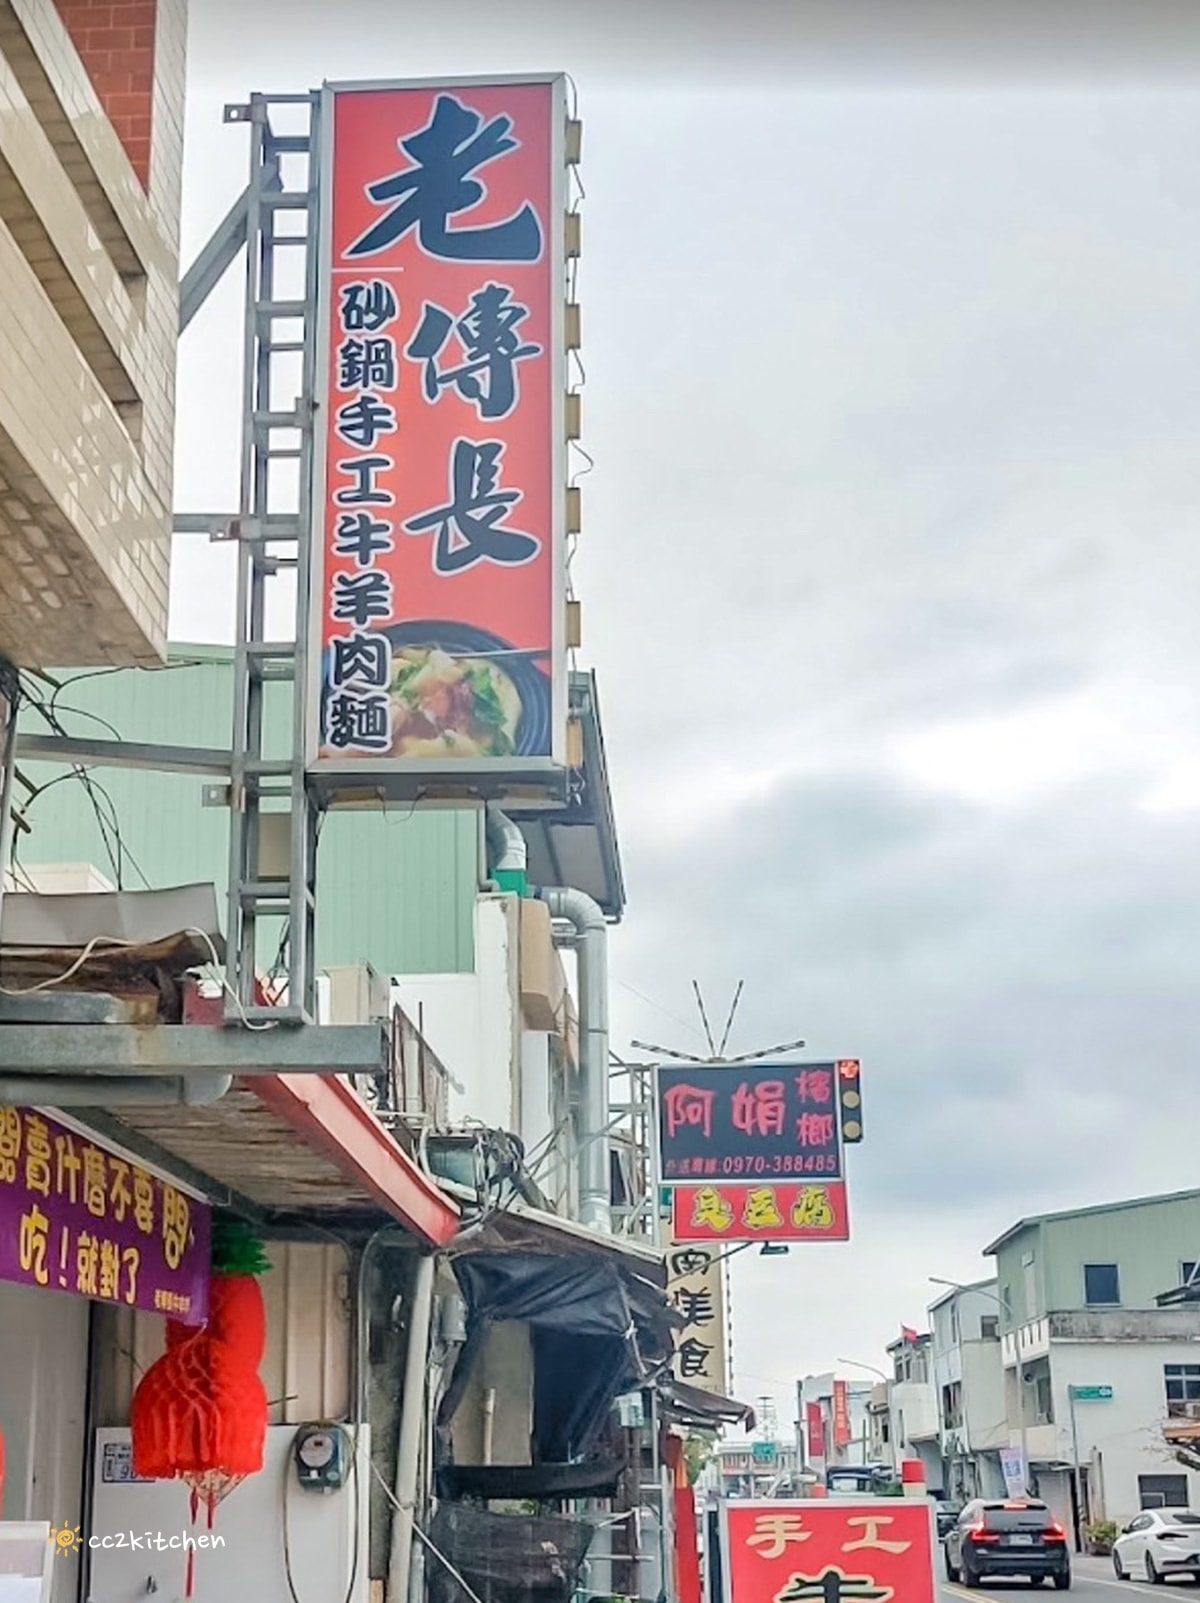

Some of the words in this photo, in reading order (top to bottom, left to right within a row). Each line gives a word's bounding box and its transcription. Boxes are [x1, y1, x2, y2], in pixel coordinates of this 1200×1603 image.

[342, 93, 543, 575] 老傳長
[327, 281, 397, 749] 砂鍋手工牛羊肉麵
[664, 1081, 786, 1139] 阿娟
[691, 1185, 835, 1231] 臭豆腐
[746, 1514, 912, 1559] 手工
